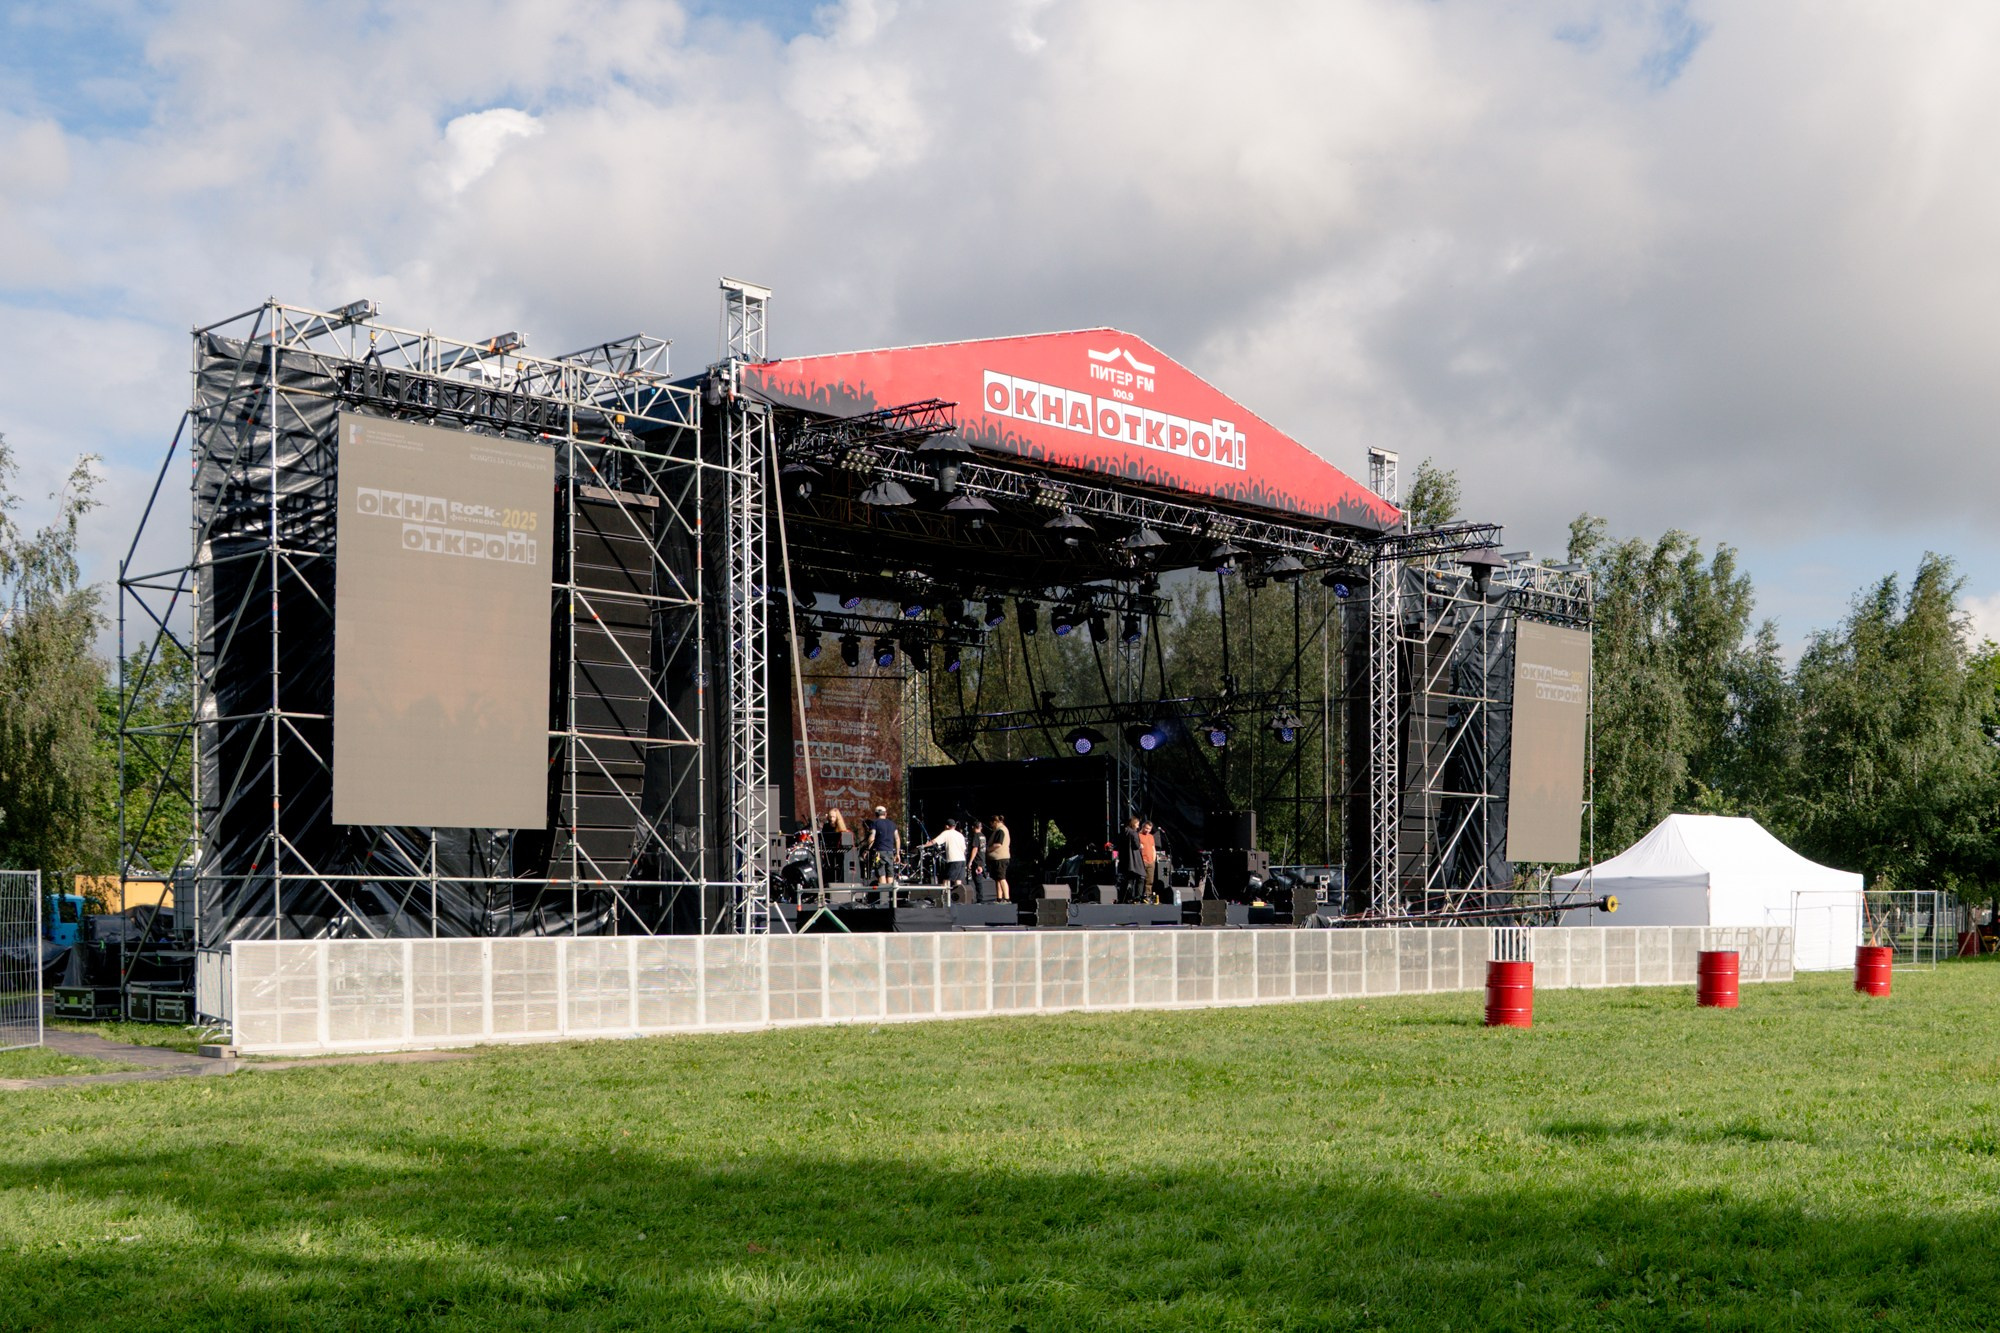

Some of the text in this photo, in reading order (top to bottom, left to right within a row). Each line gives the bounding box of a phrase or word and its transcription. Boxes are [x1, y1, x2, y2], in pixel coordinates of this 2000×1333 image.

[1090, 362, 1155, 393] ПИТЕР FM
[1112, 387, 1134, 402] 100.9
[985, 377, 1246, 470] ОКНА ОТКРОЙ!
[357, 488, 447, 525] ОКНА
[502, 507, 538, 531] 2025
[403, 525, 536, 565] ОТКРОЙ!
[1521, 664, 1552, 682] ОКНА
[825, 798, 870, 810] ПИТЕР FM
